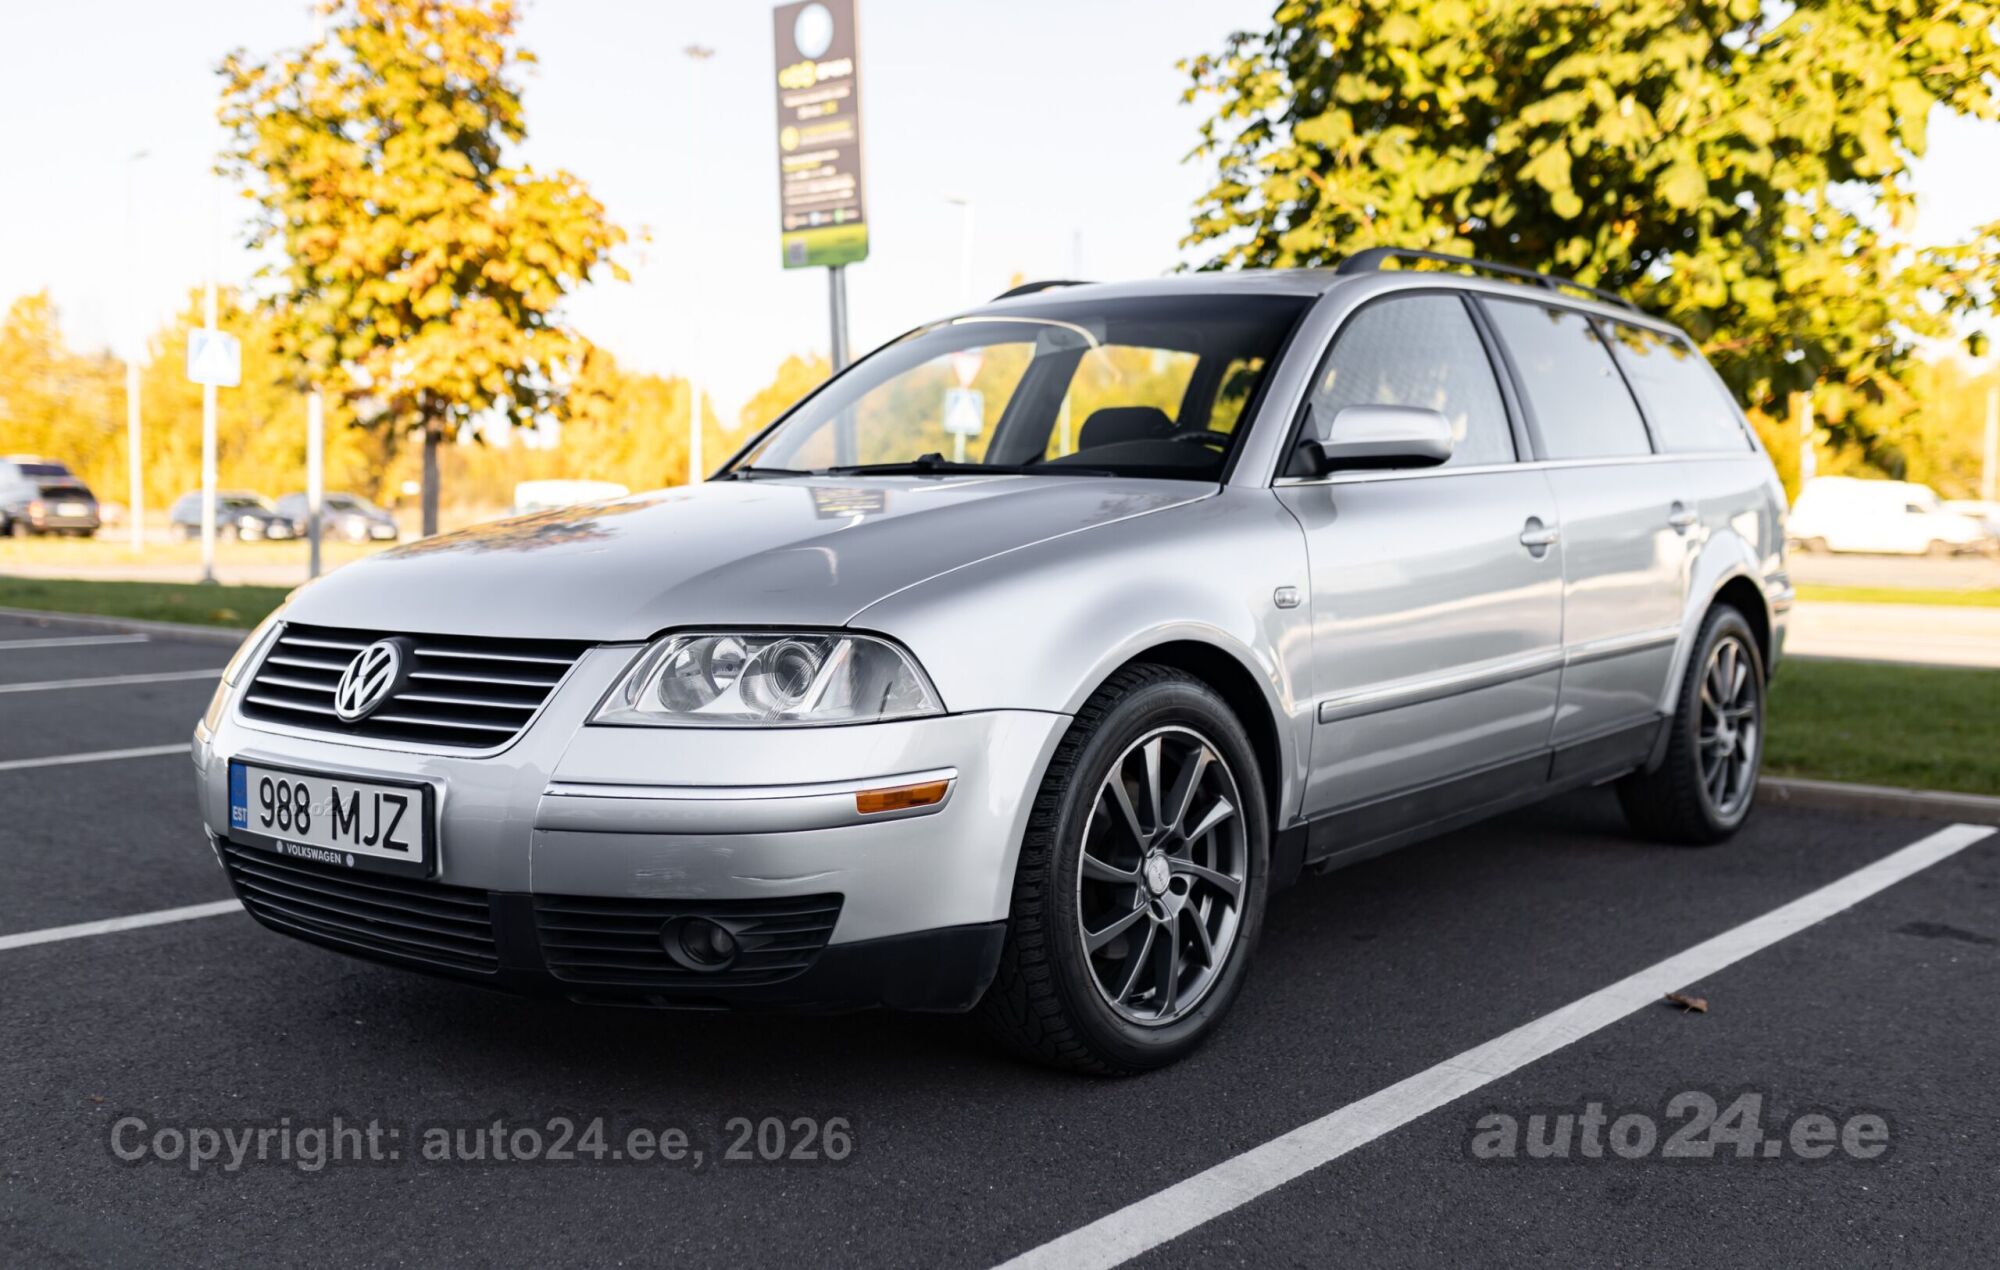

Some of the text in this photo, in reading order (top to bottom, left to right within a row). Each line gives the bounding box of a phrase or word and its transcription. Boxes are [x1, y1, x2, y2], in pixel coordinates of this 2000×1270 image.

[232, 805, 247, 822] EST
[259, 776, 409, 852] 988 MJZ
[286, 843, 342, 864] VOLKSWAGEN
